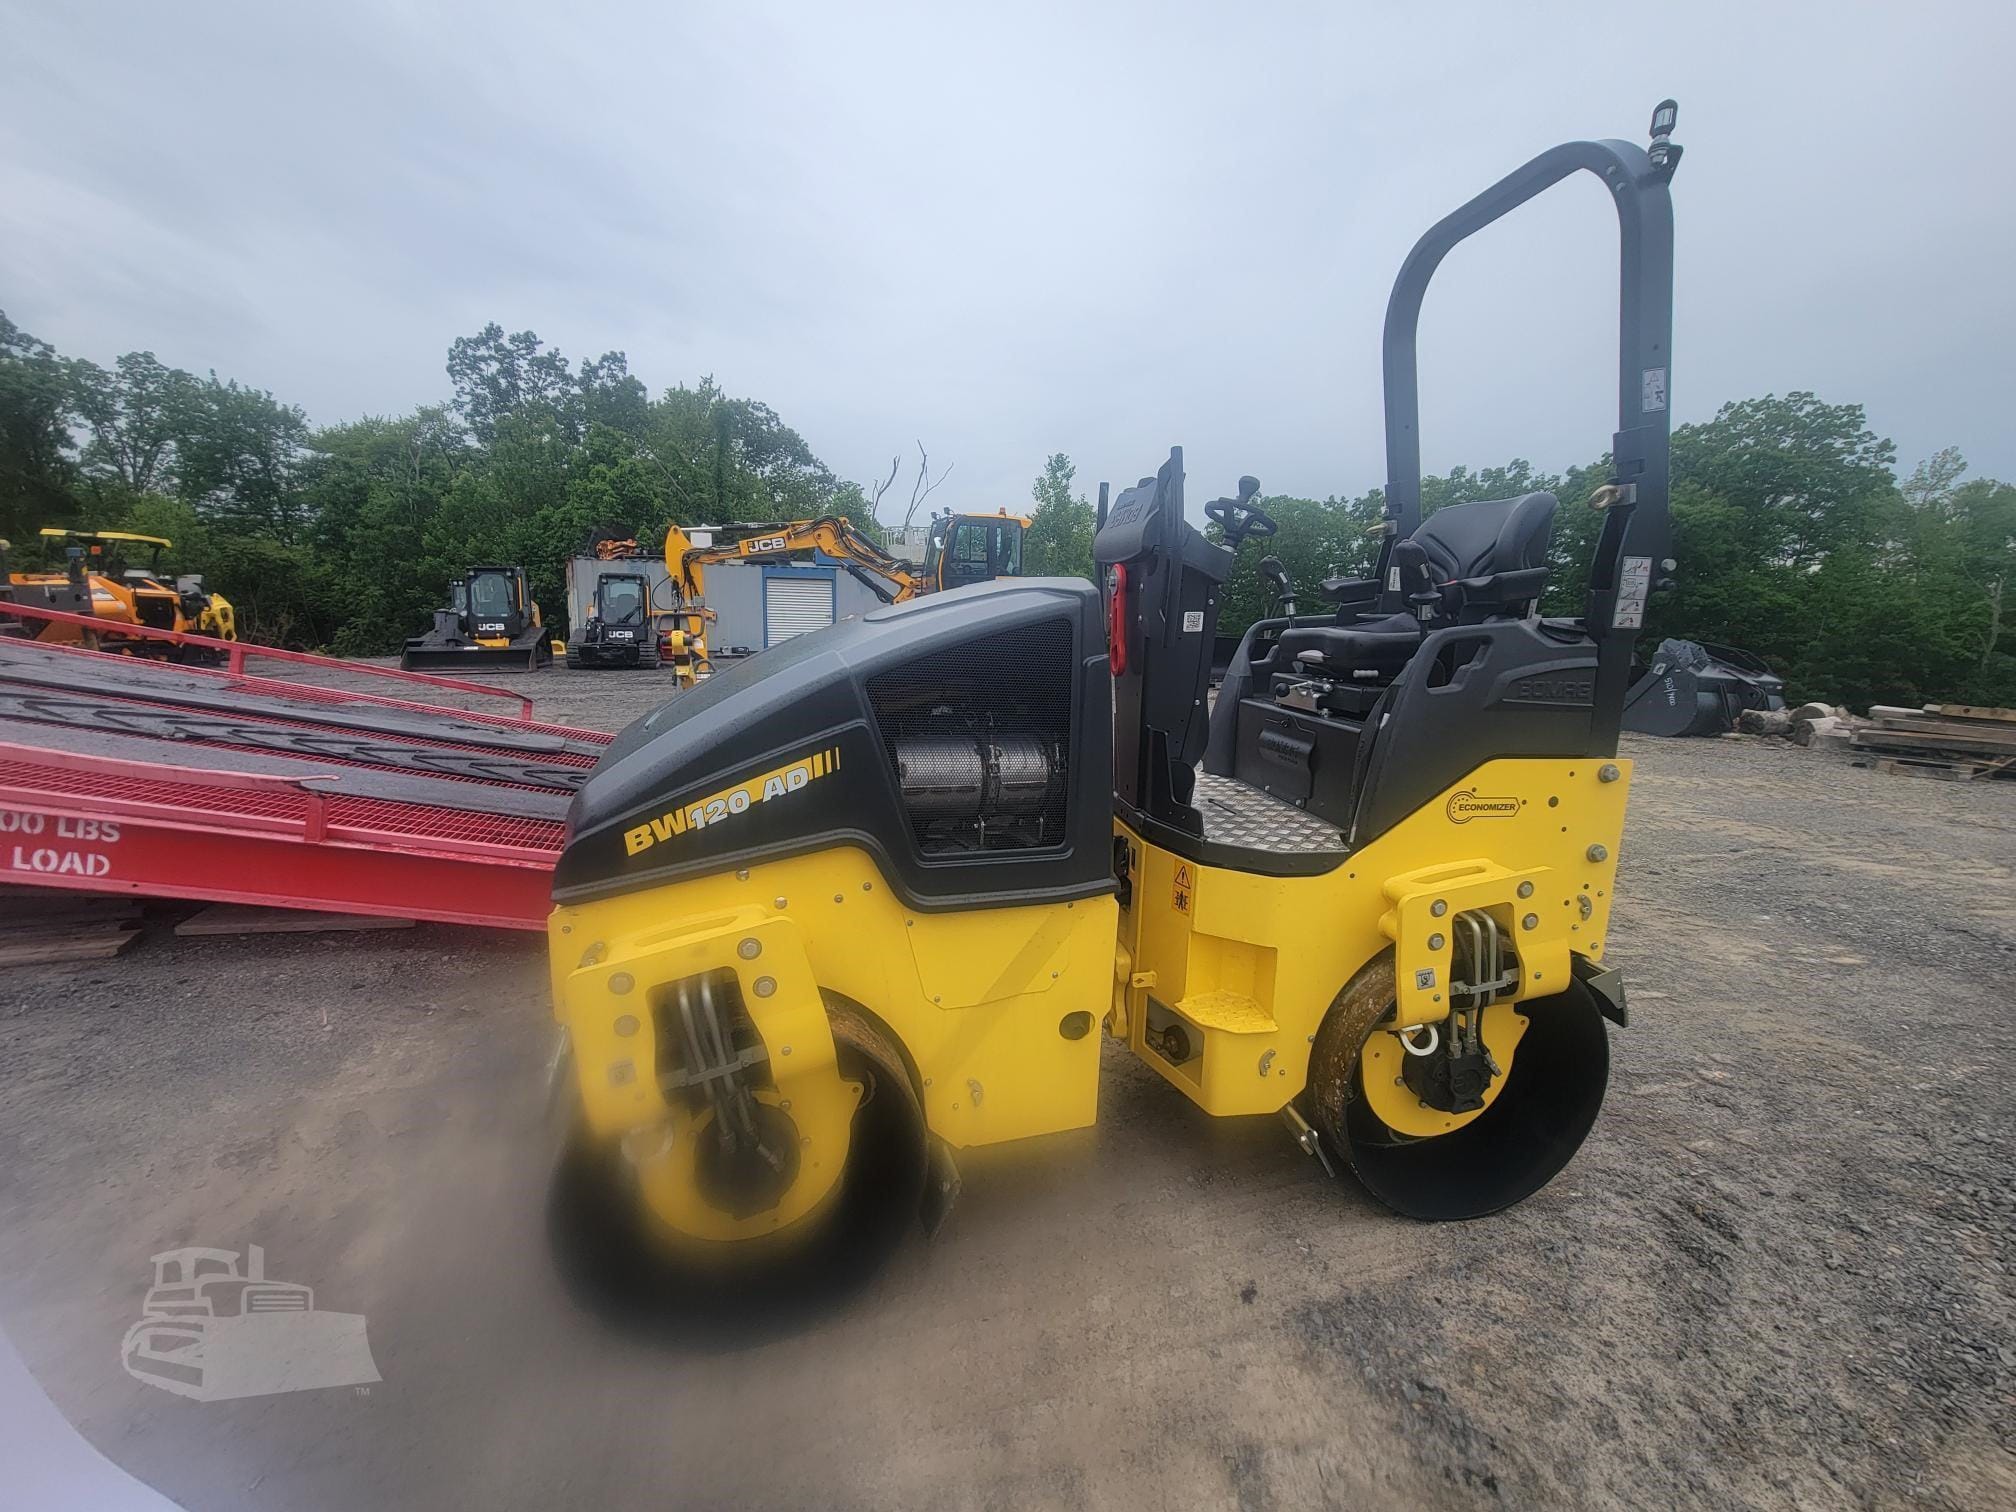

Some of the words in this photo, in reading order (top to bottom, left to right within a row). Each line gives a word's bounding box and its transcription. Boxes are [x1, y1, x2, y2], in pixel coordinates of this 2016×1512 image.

[748, 537, 786, 552] JCB
[478, 623, 505, 632] JCB
[608, 630, 634, 639] JCB
[762, 766, 809, 803] AD
[1458, 803, 1516, 812] ECONOMIZER
[57, 816, 121, 843] LBS
[13, 846, 110, 876] LOAD
